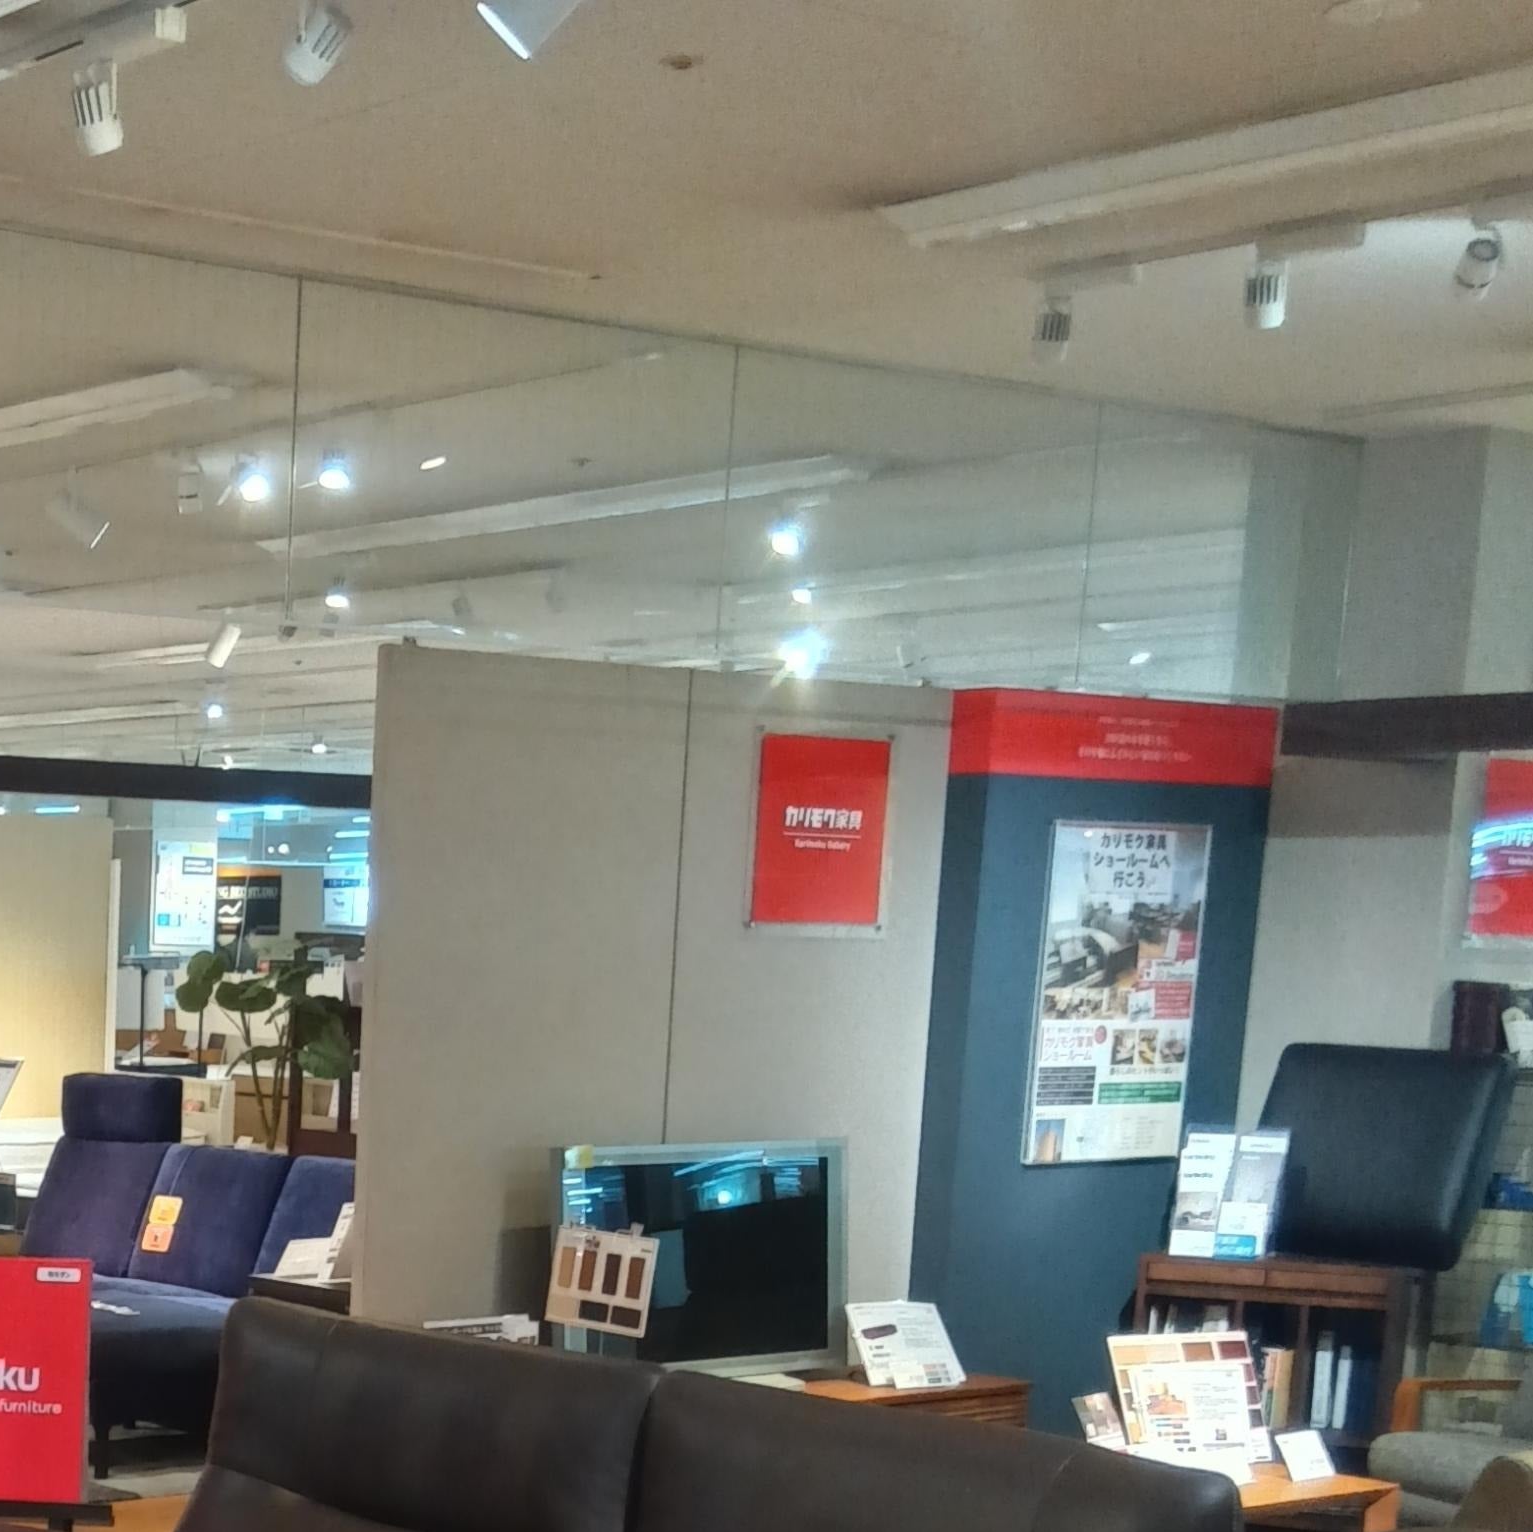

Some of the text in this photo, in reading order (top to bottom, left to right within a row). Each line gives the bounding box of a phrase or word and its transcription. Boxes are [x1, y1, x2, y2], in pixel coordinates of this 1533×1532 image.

[785, 805, 864, 831] カリモク家具
[1101, 832, 1167, 851] カリモク家具
[1093, 851, 1172, 870] ショールームへ
[0, 1398, 62, 1415] furniture
